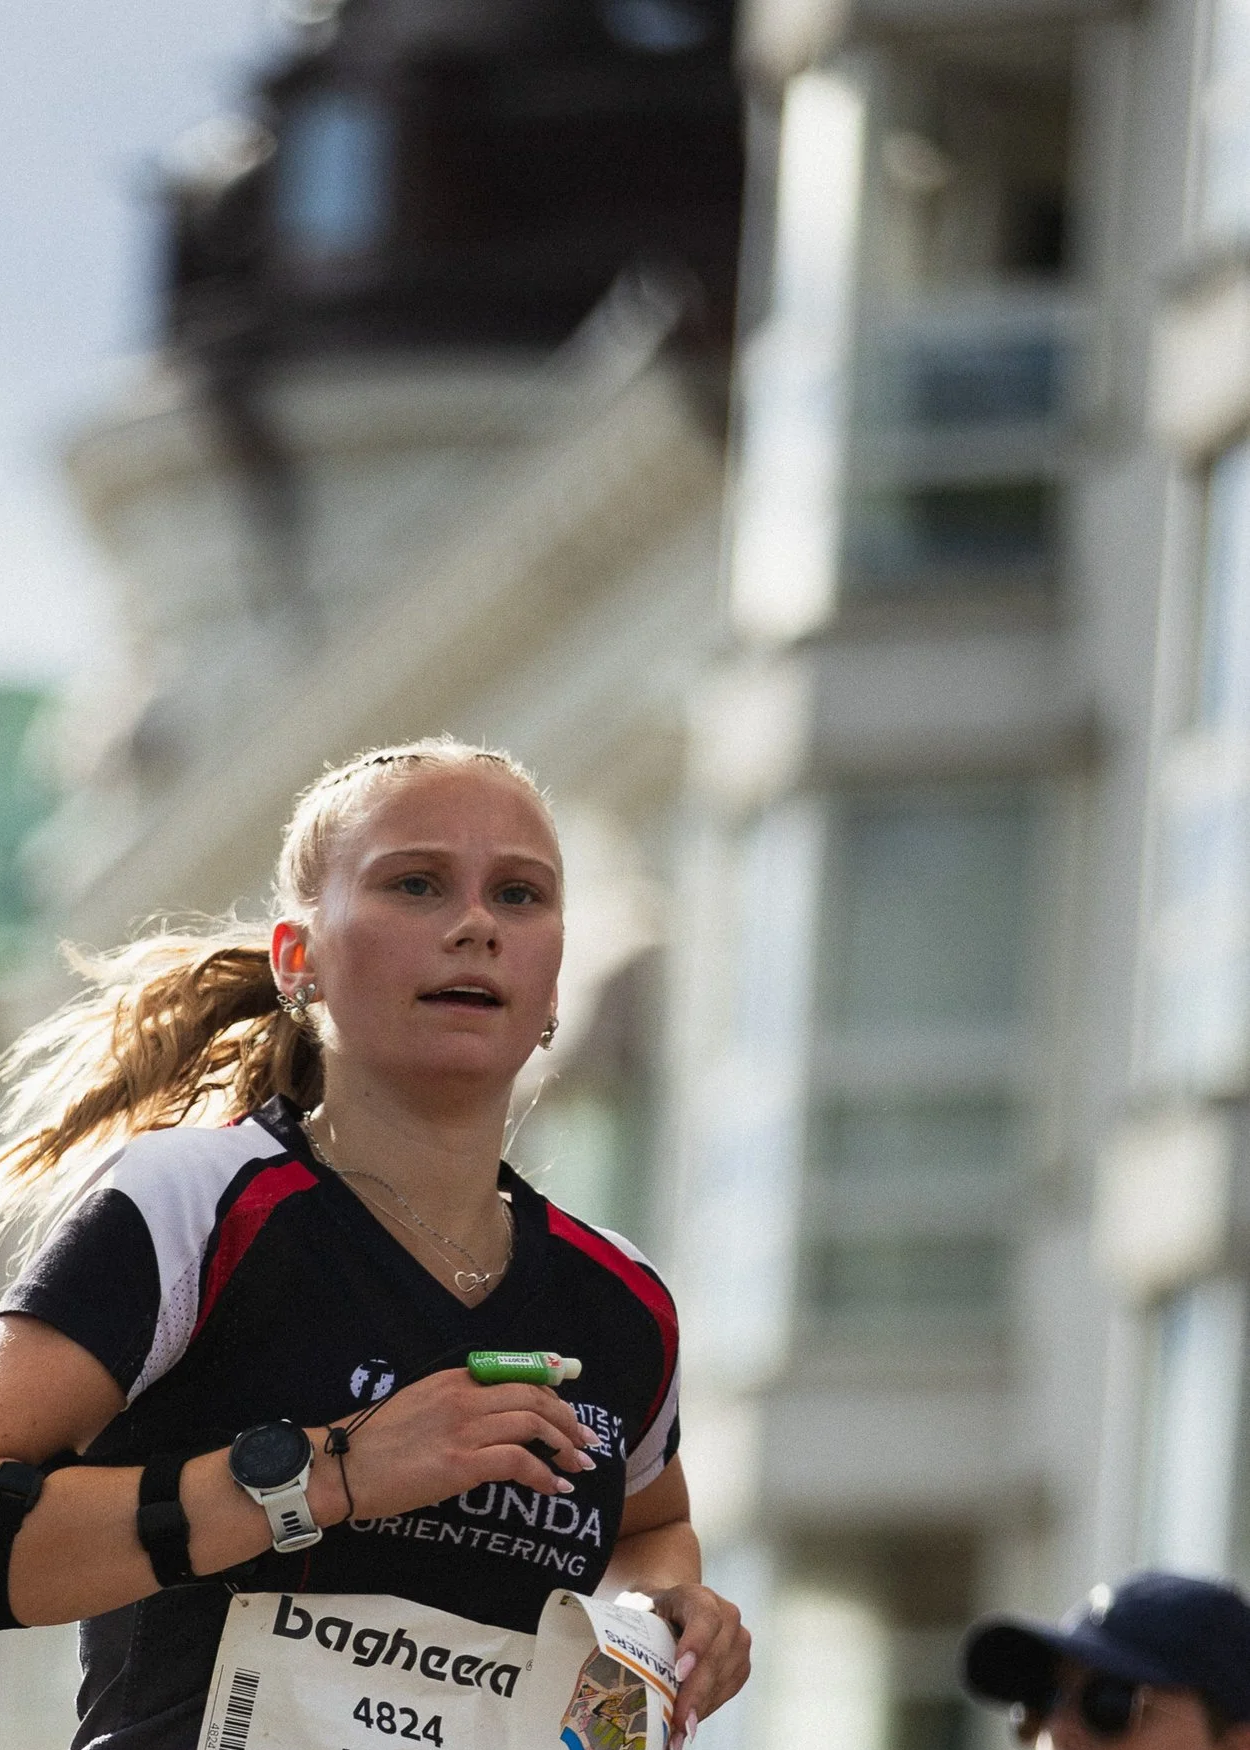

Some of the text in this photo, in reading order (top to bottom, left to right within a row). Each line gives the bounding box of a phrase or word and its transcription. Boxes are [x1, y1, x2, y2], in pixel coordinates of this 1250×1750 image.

[350, 1515, 587, 1577] ORIENTERING
[434, 1483, 601, 1548] UNDA
[272, 1594, 522, 1698] bagheera
[604, 1628, 678, 1689] HALMERS
[207, 1722, 220, 1749] 4824
[353, 1696, 444, 1748] 4824
